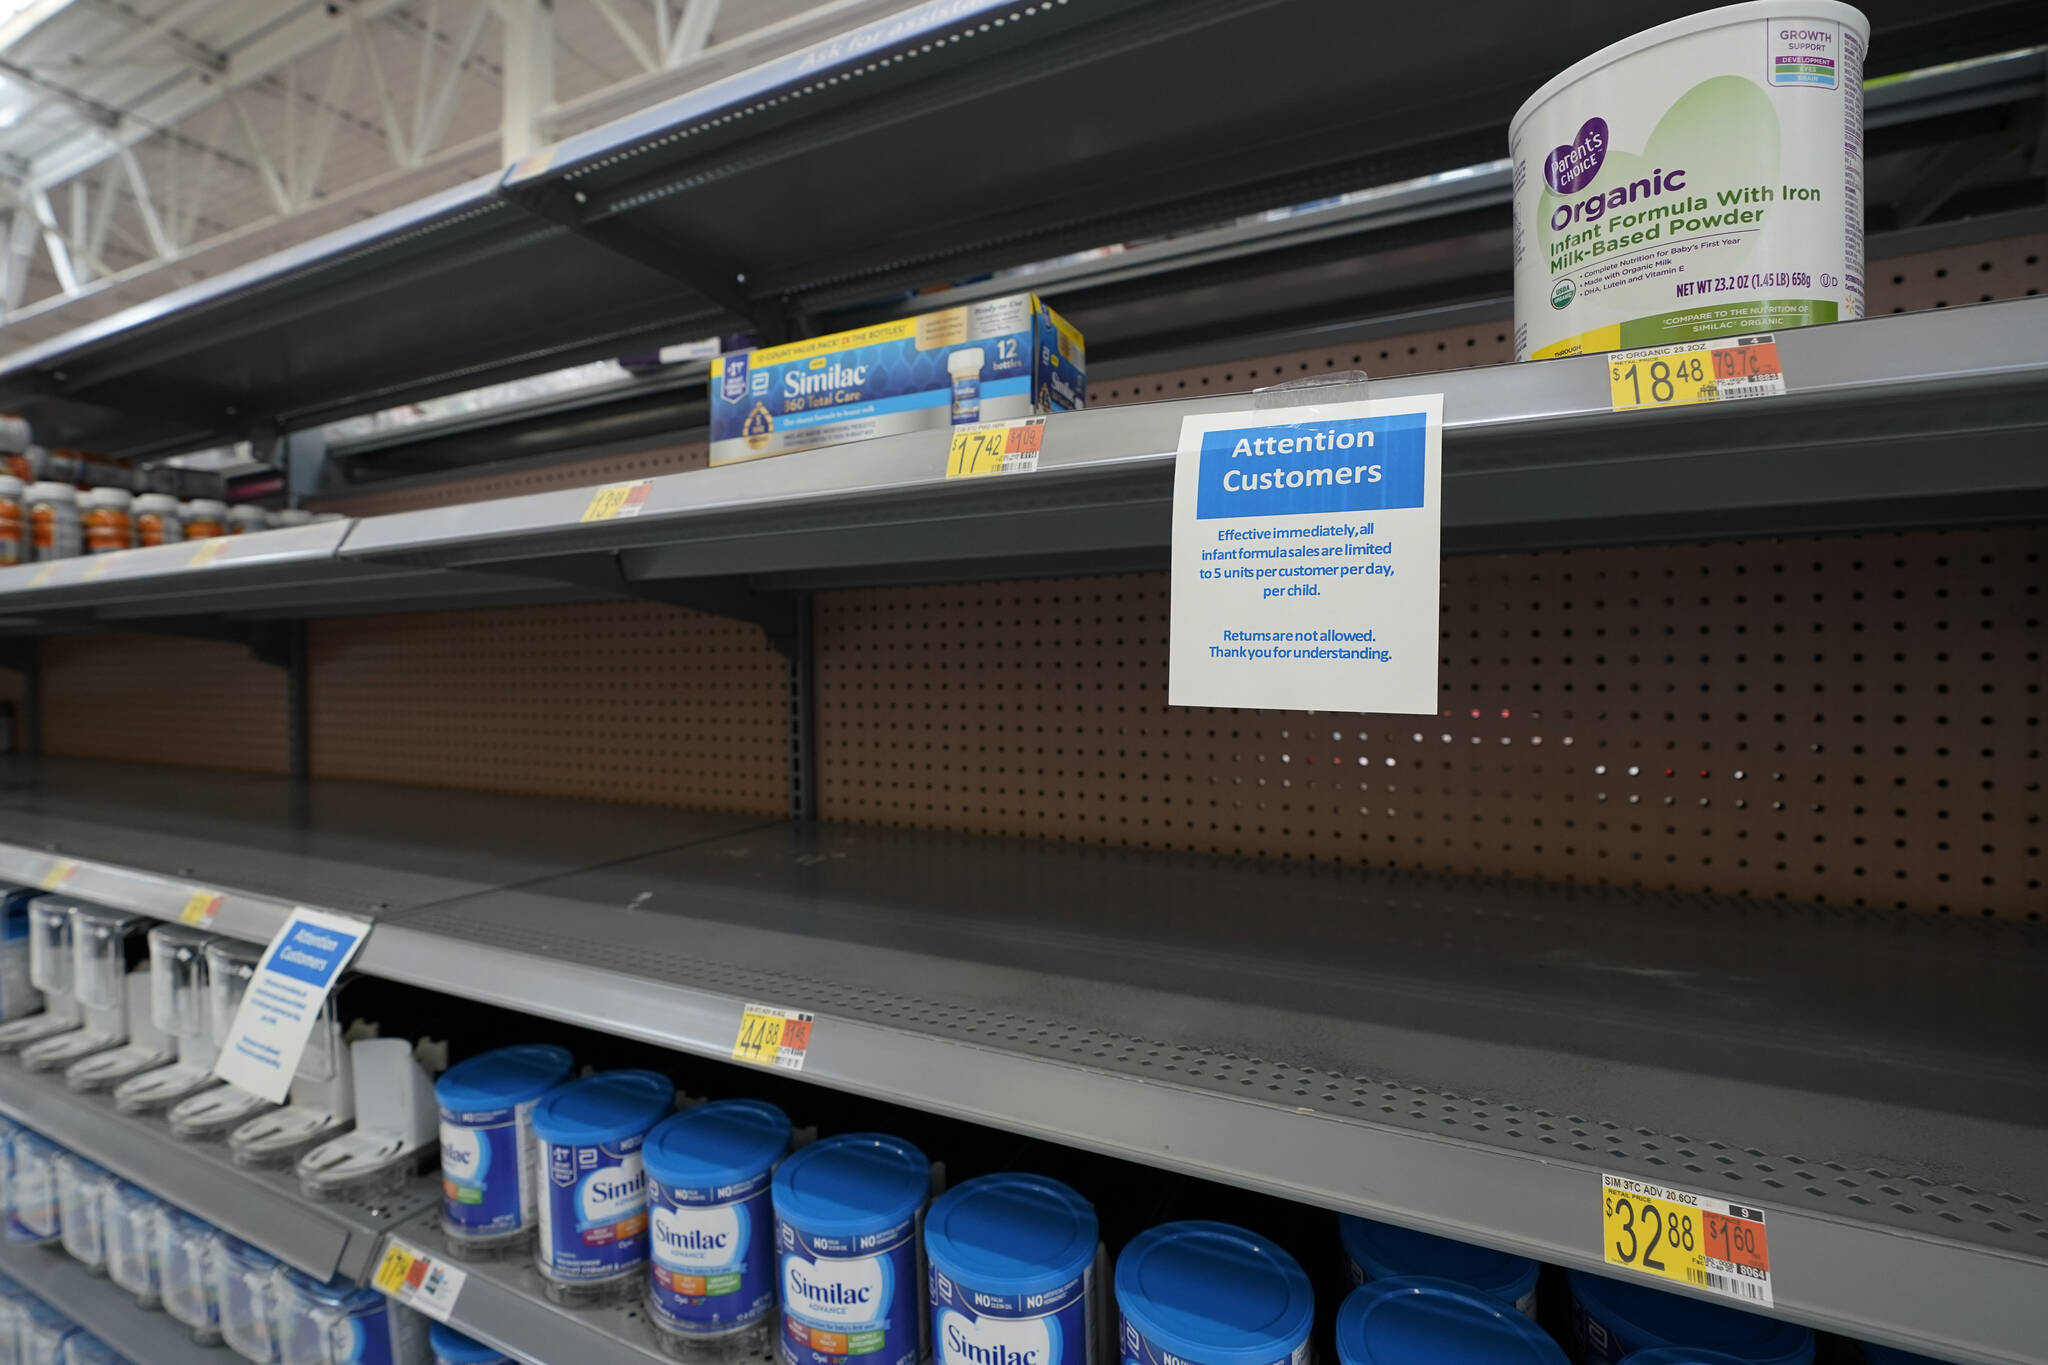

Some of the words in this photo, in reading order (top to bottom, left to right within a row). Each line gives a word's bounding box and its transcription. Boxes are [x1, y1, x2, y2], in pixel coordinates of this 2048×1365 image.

[1780, 30, 1831, 43] GROWTH
[1788, 43, 1826, 51] SUPPORT
[1782, 57, 1830, 65] DEVELOPMENT
[1551, 131, 1602, 172] Parent's
[1561, 153, 1597, 186] CHOICE
[1551, 168, 1686, 231] Organic
[1551, 224, 1601, 256] Infant
[1609, 197, 1707, 232] Formula
[1717, 186, 1774, 206] With
[1783, 185, 1820, 201] Iron
[1551, 223, 1660, 274] Milk-Based
[1670, 209, 1764, 235] Powder
[1584, 262, 1618, 278] Complete
[1620, 254, 1655, 267] Nutrition
[1656, 249, 1669, 258] for
[1671, 243, 1698, 256] Baby's
[1701, 239, 1719, 249] First
[1722, 237, 1741, 246] Year
[1584, 278, 1602, 288] Made
[1604, 271, 1620, 281] with
[1622, 264, 1653, 277] Organic
[1655, 259, 1672, 268] Milk
[1584, 288, 1602, 297] DHA,
[1603, 279, 1626, 290] Lutein
[1628, 274, 1643, 284] and
[1644, 268, 1676, 280] Vitamin
[1676, 282, 1695, 298] NET
[1697, 279, 1712, 294] WT
[1714, 276, 1734, 292] 23.2
[1737, 275, 1749, 289] OZ
[1751, 273, 1775, 290] (1.45
[1776, 272, 1790, 288] LB)
[1791, 272, 1811, 288] 658g
[1715, 310, 1727, 318] TO
[1729, 308, 1748, 317] THE
[1750, 305, 1797, 315] NUTRITION
[1798, 305, 1809, 313] OF
[1693, 321, 1733, 333] SIMILAC
[1740, 317, 1784, 327] ORGANIC
[997, 339, 1017, 359] 12
[1554, 344, 1582, 357] THROUGH
[1610, 353, 1624, 361] PC
[1626, 348, 1670, 359] ORGANIC
[993, 359, 1022, 370] bottles
[784, 363, 866, 398] Similac
[784, 397, 805, 412] 360
[808, 393, 833, 408] Total
[835, 390, 861, 404] Care
[1232, 430, 1375, 458] Attention
[1223, 464, 1382, 492] Customers
[1218, 529, 1271, 541] Effective
[1360, 523, 1374, 535] all
[1202, 549, 1237, 560] infant
[1239, 547, 1287, 559] formula
[1288, 546, 1319, 557] sales
[1321, 547, 1343, 556] are
[1345, 542, 1392, 555] limited
[1200, 569, 1212, 579] to
[1214, 568, 1221, 578] 5
[1224, 567, 1254, 578] units
[1256, 568, 1277, 580] per
[1278, 565, 1339, 577] customer
[1341, 564, 1363, 577] per
[1365, 562, 1394, 577] day,
[1263, 586, 1285, 599] per
[1287, 584, 1320, 596] child.
[1224, 630, 1271, 641] Returns
[1272, 632, 1294, 641] are
[1295, 630, 1318, 641] not
[1320, 629, 1376, 642] allowed.
[1209, 646, 1247, 658] Thank
[1248, 649, 1271, 660] you
[1273, 647, 1292, 658] for
[1294, 647, 1392, 662] understanding.
[592, 1169, 645, 1203] Simil
[675, 1189, 687, 1200] NO
[718, 1186, 732, 1199] NO
[1605, 1176, 1621, 1188] SIM
[1624, 1181, 1641, 1192] 3TC
[1643, 1185, 1663, 1197] ADV
[1608, 1188, 1631, 1199] RETAIL
[1632, 1194, 1651, 1203] PRICE
[1741, 1208, 1749, 1217] 9
[656, 1219, 727, 1250] Similac
[814, 1237, 828, 1250] NO
[860, 1236, 876, 1249] NO
[791, 1269, 870, 1305] Similac
[809, 1303, 847, 1315] ADVANCE
[975, 1293, 990, 1308] NO
[1027, 1294, 1043, 1309] NO
[948, 1324, 1036, 1365] Similac
